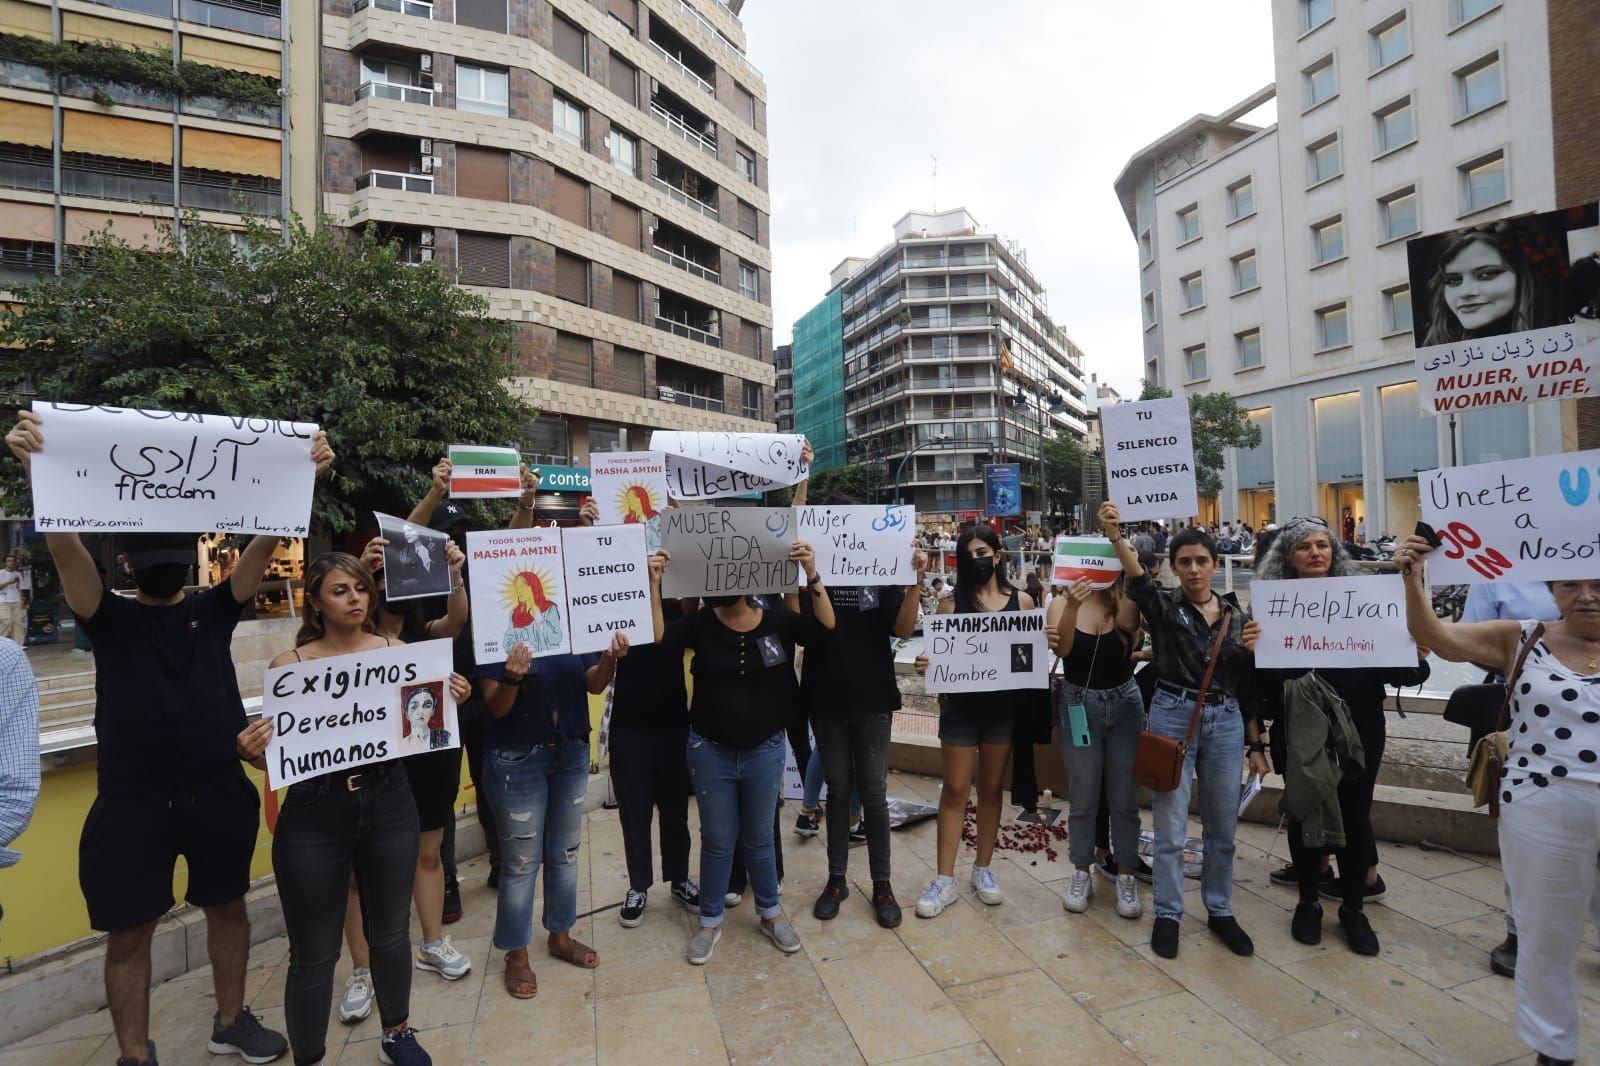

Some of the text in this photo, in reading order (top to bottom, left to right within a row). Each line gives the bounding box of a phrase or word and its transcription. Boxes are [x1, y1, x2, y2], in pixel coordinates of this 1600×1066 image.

[1436, 357, 1591, 392] MUJER, VIDA,
[1433, 378, 1591, 412] WOMAN, LIFE,
[1136, 411, 1152, 421] TU
[1117, 436, 1177, 450] SILENCIO
[595, 465, 662, 475] MASHA AMINI
[1111, 463, 1189, 479] NOS CUESTA
[114, 474, 215, 501] freedom
[1430, 465, 1600, 510] Únete U
[1127, 492, 1178, 505] LA VIDA
[39, 516, 144, 528] #mahsaamini
[667, 510, 736, 535] MUJER
[800, 508, 852, 535] Mujer
[1514, 513, 1540, 529] a
[488, 535, 543, 545] TODOS SOMOS
[597, 537, 612, 546] TU
[697, 535, 763, 561] VIDA
[473, 545, 558, 560] MASHA AMINI
[578, 563, 635, 577] SILENCIO
[831, 554, 898, 577] Libertad
[1080, 558, 1104, 567] IRAN
[704, 559, 799, 592] LIBERTAD
[572, 590, 646, 606] NOS CUESTA
[1267, 590, 1399, 624] #helpIran
[588, 619, 636, 633] LA VIDA
[930, 614, 1043, 633] #MAHSAAMINI
[933, 635, 989, 655] Di Su
[272, 661, 417, 699] Exigimos
[933, 664, 997, 683] Nombre
[277, 702, 387, 737] Derechos
[279, 740, 388, 780] humanos
